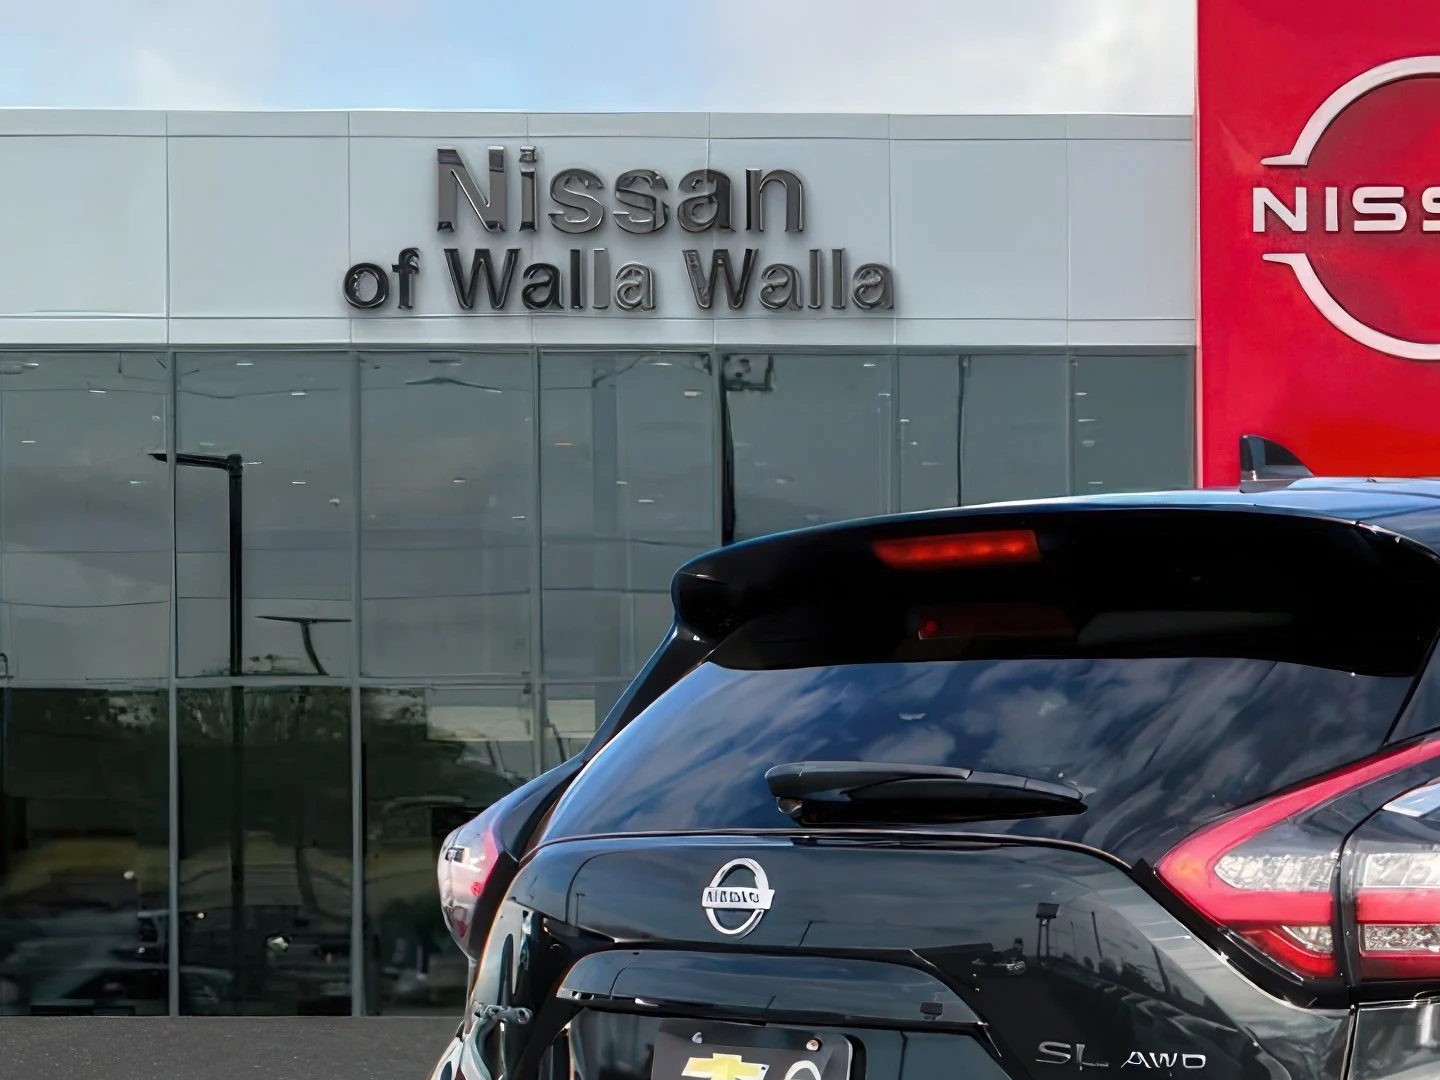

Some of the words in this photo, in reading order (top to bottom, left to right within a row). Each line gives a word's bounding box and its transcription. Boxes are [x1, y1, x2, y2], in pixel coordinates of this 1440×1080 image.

[436, 146, 805, 234] Nissan
[342, 247, 422, 309] of
[443, 247, 656, 310] Walla
[682, 247, 895, 310] Walla
[1036, 1041, 1109, 1071] SL
[1120, 1051, 1207, 1069] AWD
